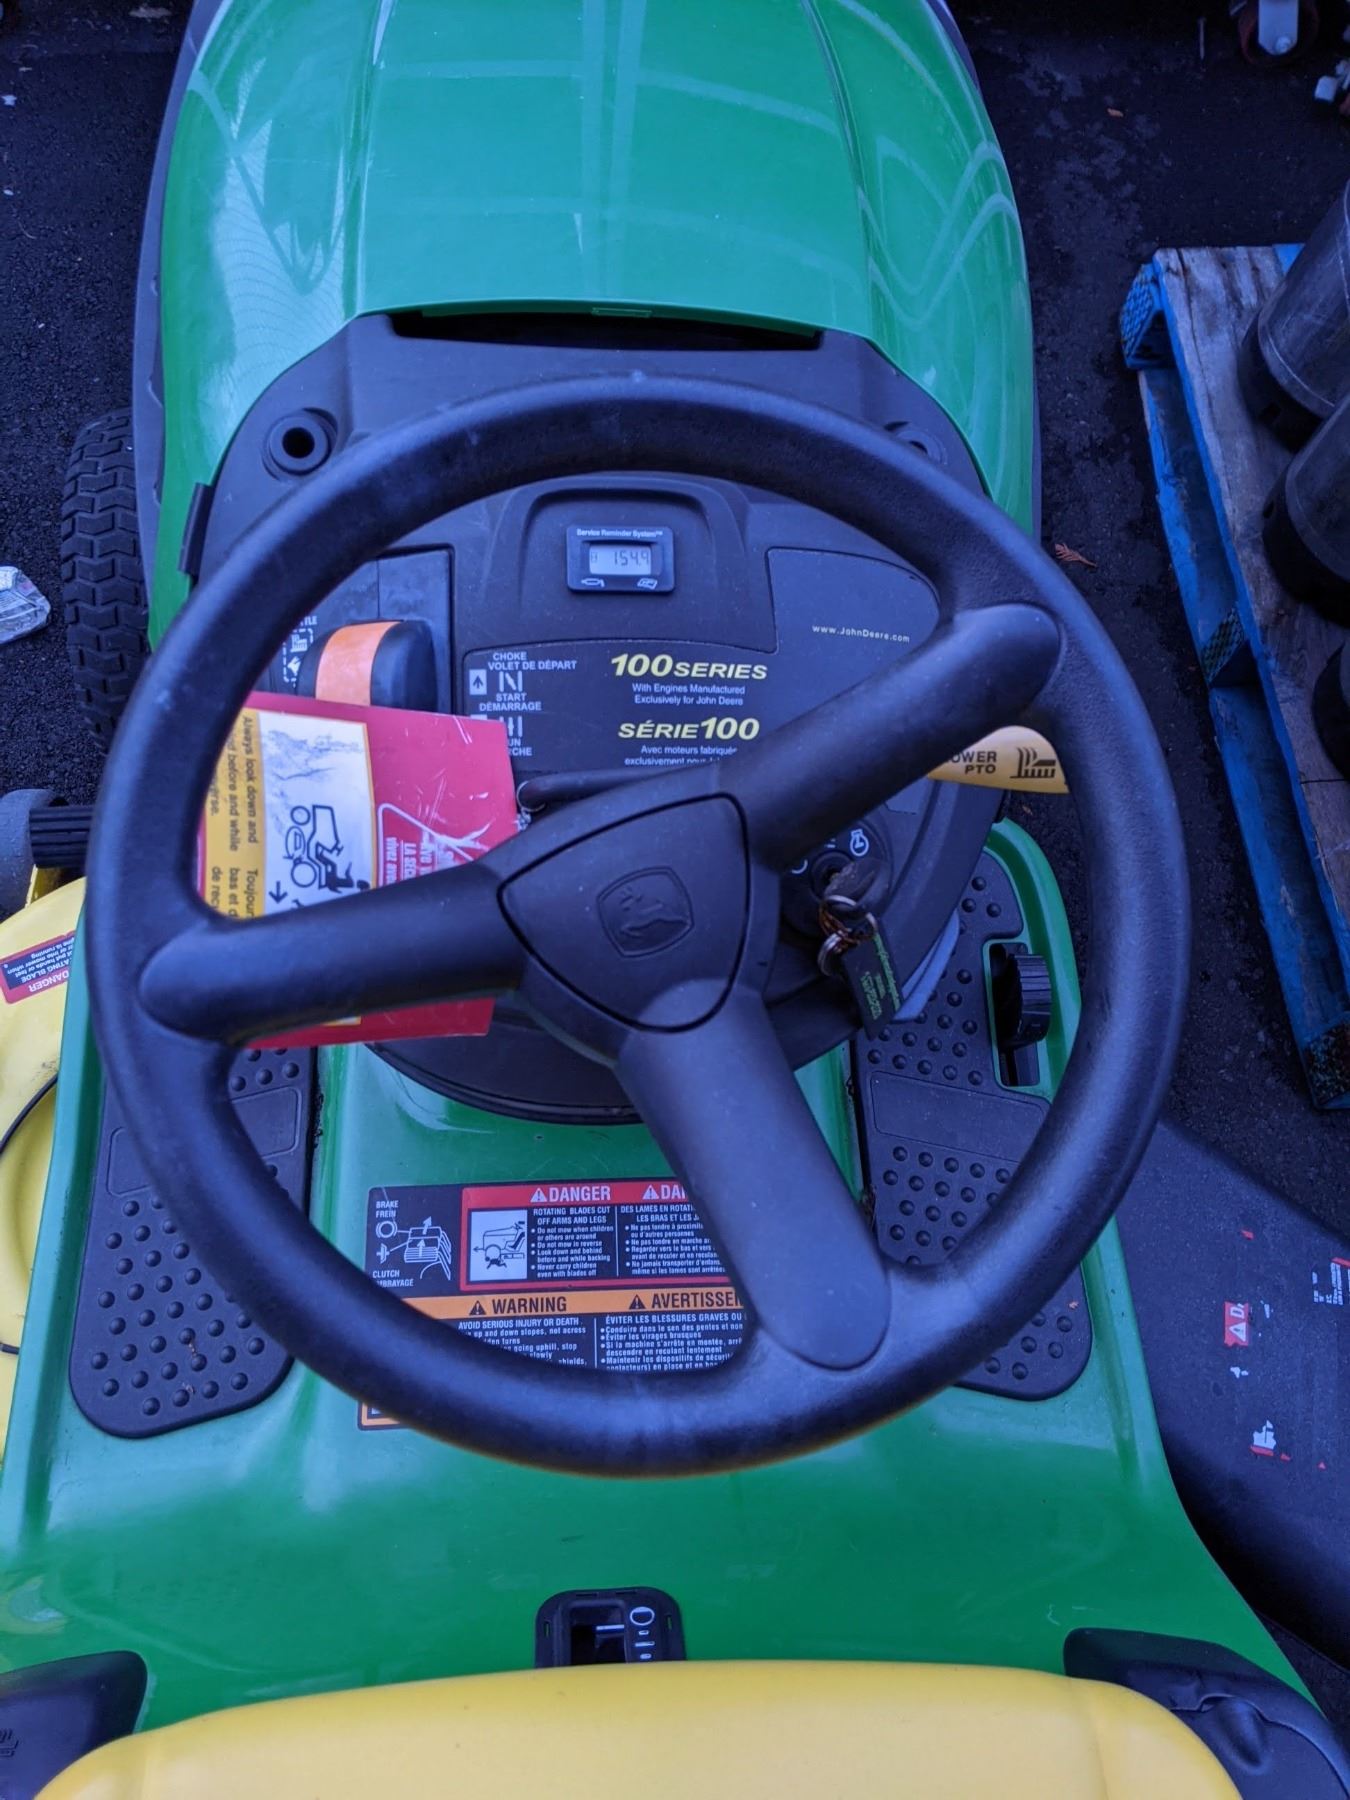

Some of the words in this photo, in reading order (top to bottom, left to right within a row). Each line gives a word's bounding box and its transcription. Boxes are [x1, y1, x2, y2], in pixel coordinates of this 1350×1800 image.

[812, 625, 909, 642] www.JohnDeere.com
[493, 651, 527, 660] CHOKE
[488, 662, 520, 670] VOLET
[522, 662, 536, 670] DE
[538, 659, 577, 669] DÉPART
[632, 683, 651, 692] With
[654, 684, 688, 694] Engines
[690, 684, 745, 694] Manufactured
[496, 693, 527, 701] START
[634, 695, 681, 705] Exclusively
[683, 695, 693, 703] for
[696, 696, 716, 705] John
[719, 697, 743, 705] Deere
[479, 701, 542, 711] DÉMARRAGE
[618, 720, 699, 739] SÉRIE
[641, 745, 662, 754] Avec
[665, 746, 698, 754] moteurs
[952, 751, 996, 763] OWER
[246, 758, 256, 782] look
[965, 764, 996, 774] PTO
[247, 785, 257, 817] down
[244, 869, 258, 917] Toujour
[29, 970, 69, 992] DANGER
[549, 1186, 611, 1202] DANGER
[376, 1200, 399, 1208] BRAKE
[621, 1205, 633, 1213] DES
[376, 1210, 396, 1218] FREIN
[533, 1208, 566, 1216] ROTATING
[574, 1216, 587, 1224] AND
[650, 1214, 668, 1222] BRAS
[372, 1270, 400, 1278] CLUTCH
[492, 1296, 567, 1314] WARNING
[606, 1315, 633, 1324] ÉVITER
[636, 1315, 649, 1323] LES
[652, 1314, 696, 1322] BLESSURES
[699, 1313, 728, 1322] GRAVES
[458, 1321, 480, 1330] AVOID
[482, 1320, 513, 1329] SERIOUS
[516, 1319, 541, 1328] INJURY
[556, 1318, 578, 1326] DEATH
